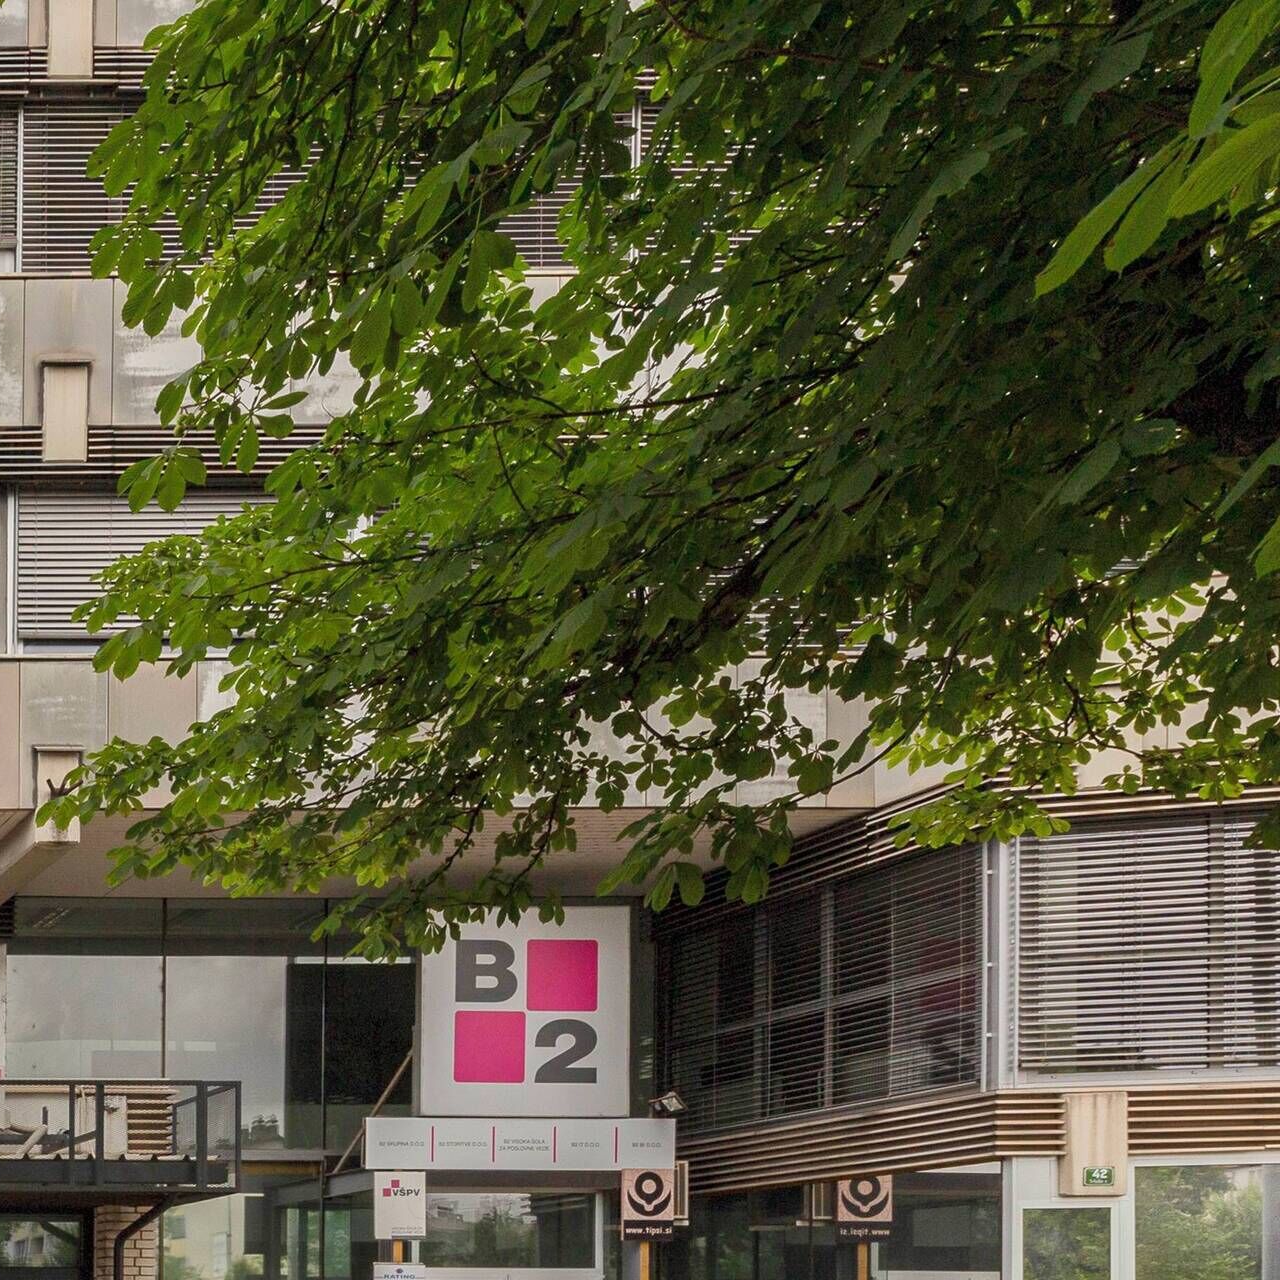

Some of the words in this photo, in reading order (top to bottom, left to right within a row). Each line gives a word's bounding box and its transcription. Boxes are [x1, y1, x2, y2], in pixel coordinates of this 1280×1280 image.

[455, 940, 518, 1002] B
[534, 1018, 597, 1083] 2
[1091, 1168, 1108, 1179] 42
[392, 1187, 421, 1197] VŠPV
[625, 1226, 673, 1236] www.tipsi.si
